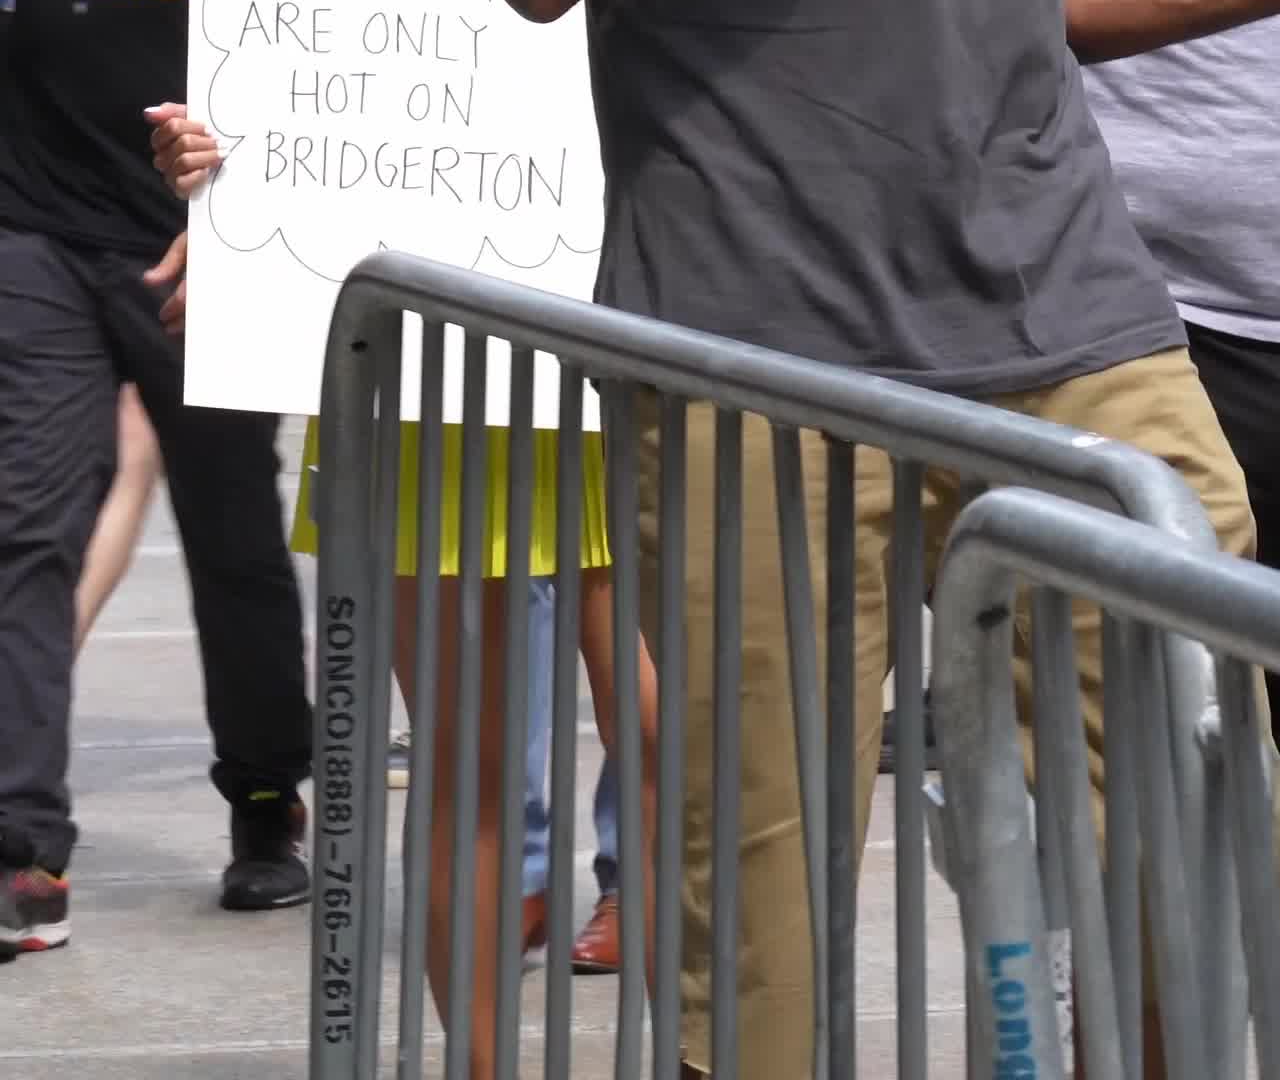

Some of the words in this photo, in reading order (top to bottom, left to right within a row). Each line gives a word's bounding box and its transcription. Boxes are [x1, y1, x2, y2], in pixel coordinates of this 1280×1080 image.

[238, 0, 333, 54] ARE
[362, 11, 488, 69] ONLY
[289, 69, 377, 115] HOT
[406, 75, 474, 127] ON
[265, 129, 567, 212] BRIDGERTON
